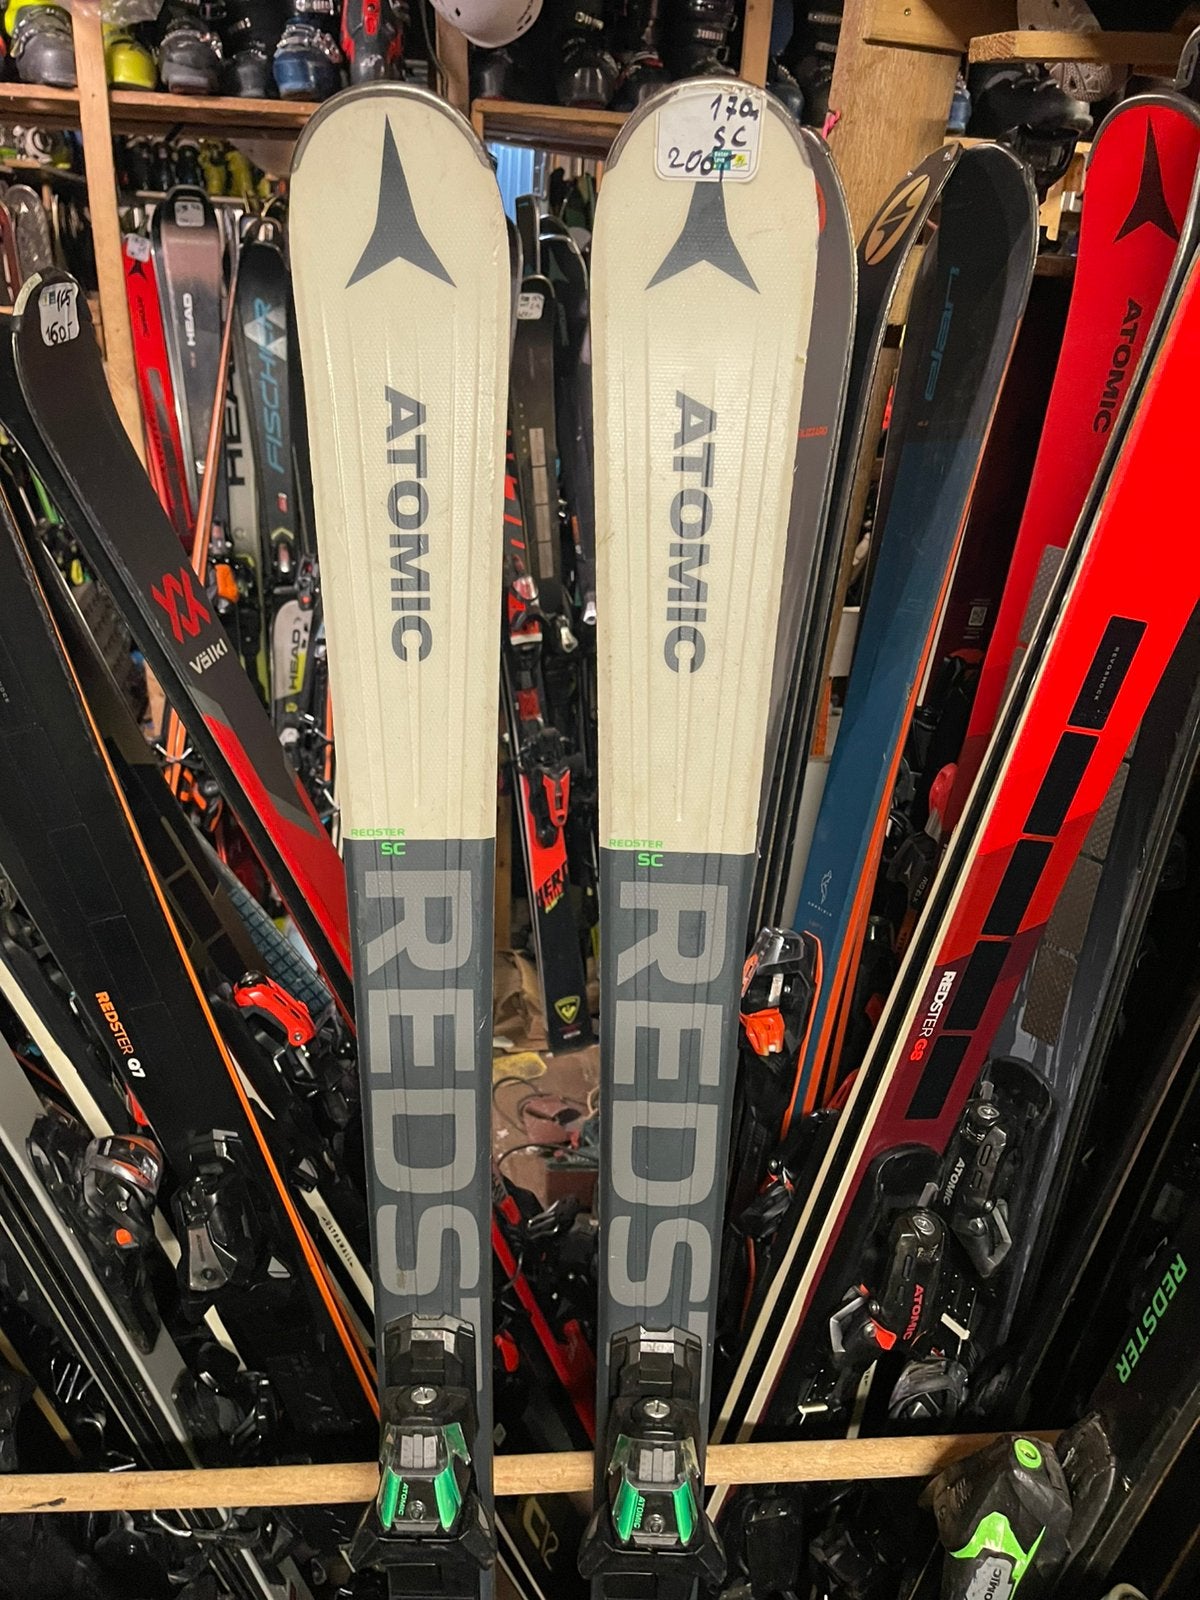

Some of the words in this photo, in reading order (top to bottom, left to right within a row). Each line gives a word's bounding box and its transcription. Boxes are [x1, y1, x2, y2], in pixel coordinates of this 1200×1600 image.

[182, 293, 197, 347] HEAD
[254, 297, 285, 474] FISCHER
[1092, 297, 1143, 433] ATOMIC
[385, 385, 433, 662] ATOMIC
[664, 390, 718, 674] ATOMIC
[188, 637, 229, 675] Völkl
[288, 628, 302, 690] HEAD
[1093, 646, 1120, 701] REVOSHOCK
[350, 827, 406, 837] REDSTER
[381, 842, 406, 856] SC
[608, 838, 664, 849] REDSTER
[637, 852, 664, 867] SC
[919, 971, 957, 1037] REDSTER
[95, 991, 135, 1055] REDSTER
[127, 1057, 146, 1078] Q7
[942, 1156, 966, 1206] ATOMIC
[902, 1284, 925, 1341] ATOMIC
[1115, 1252, 1188, 1384] REDSTER
[398, 1482, 410, 1516] ATOMIC
[633, 1495, 647, 1529] ATOMIC
[984, 1567, 1003, 1600] OMIC
